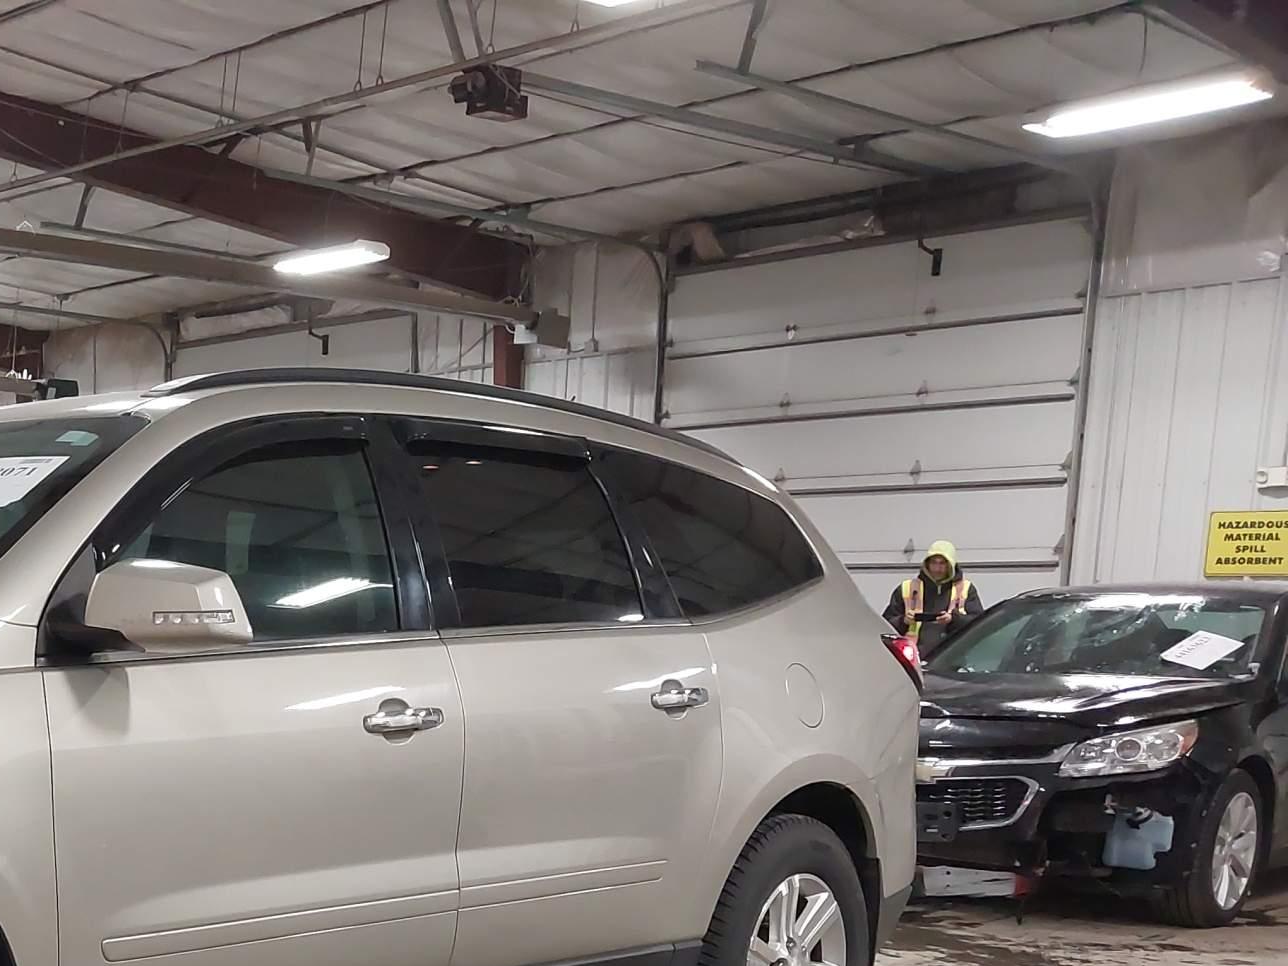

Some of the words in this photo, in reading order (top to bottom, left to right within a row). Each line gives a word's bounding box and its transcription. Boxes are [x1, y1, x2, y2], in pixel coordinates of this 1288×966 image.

[1217, 520, 1288, 529] HAZARDOUS
[1223, 532, 1281, 541] MATERIAL
[1235, 545, 1267, 553] SPILL
[1215, 557, 1284, 565] ABSORBENT
